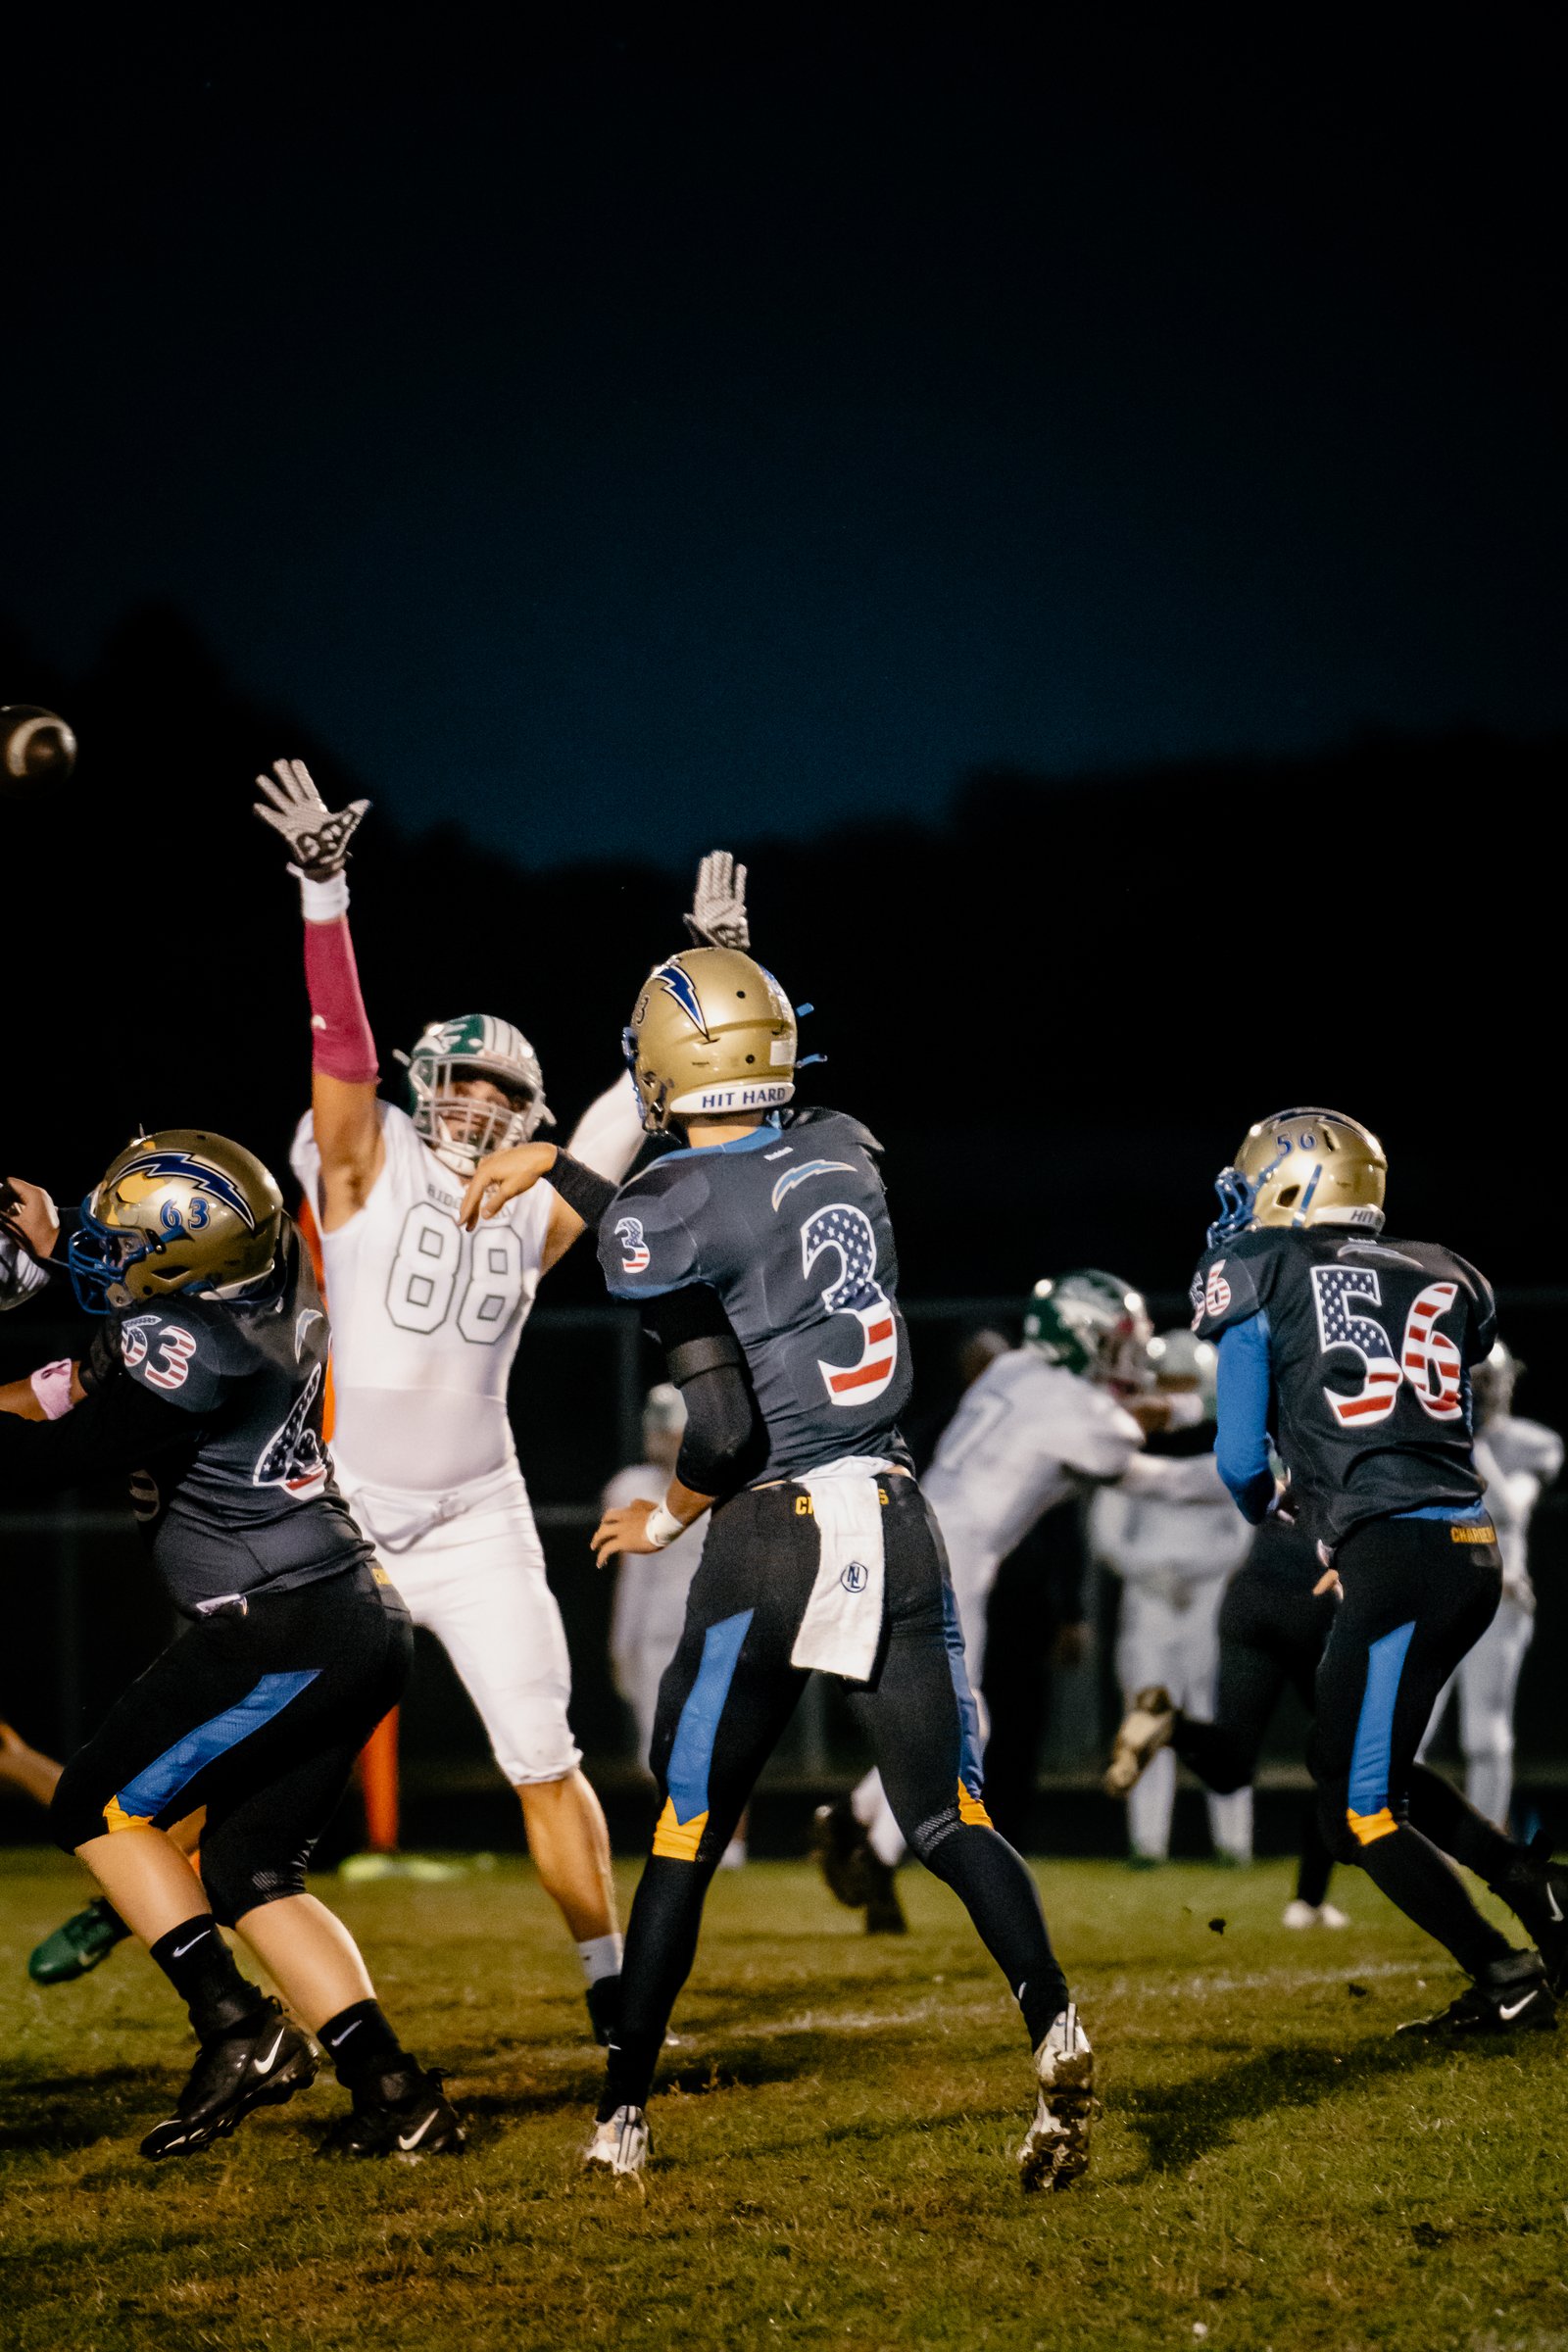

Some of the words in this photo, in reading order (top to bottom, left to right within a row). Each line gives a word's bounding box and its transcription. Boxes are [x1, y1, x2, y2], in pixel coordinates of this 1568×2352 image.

[702, 1093, 734, 1108] HIT
[743, 1088, 786, 1104] HARD
[1277, 1133, 1316, 1157] 56
[160, 1198, 211, 1231] 63
[613, 1216, 651, 1274] 3
[385, 1201, 523, 1346] 88
[800, 1202, 898, 1406] 3
[1189, 1258, 1231, 1332] 56
[121, 1314, 196, 1390] 63
[1310, 1264, 1463, 1428] 56
